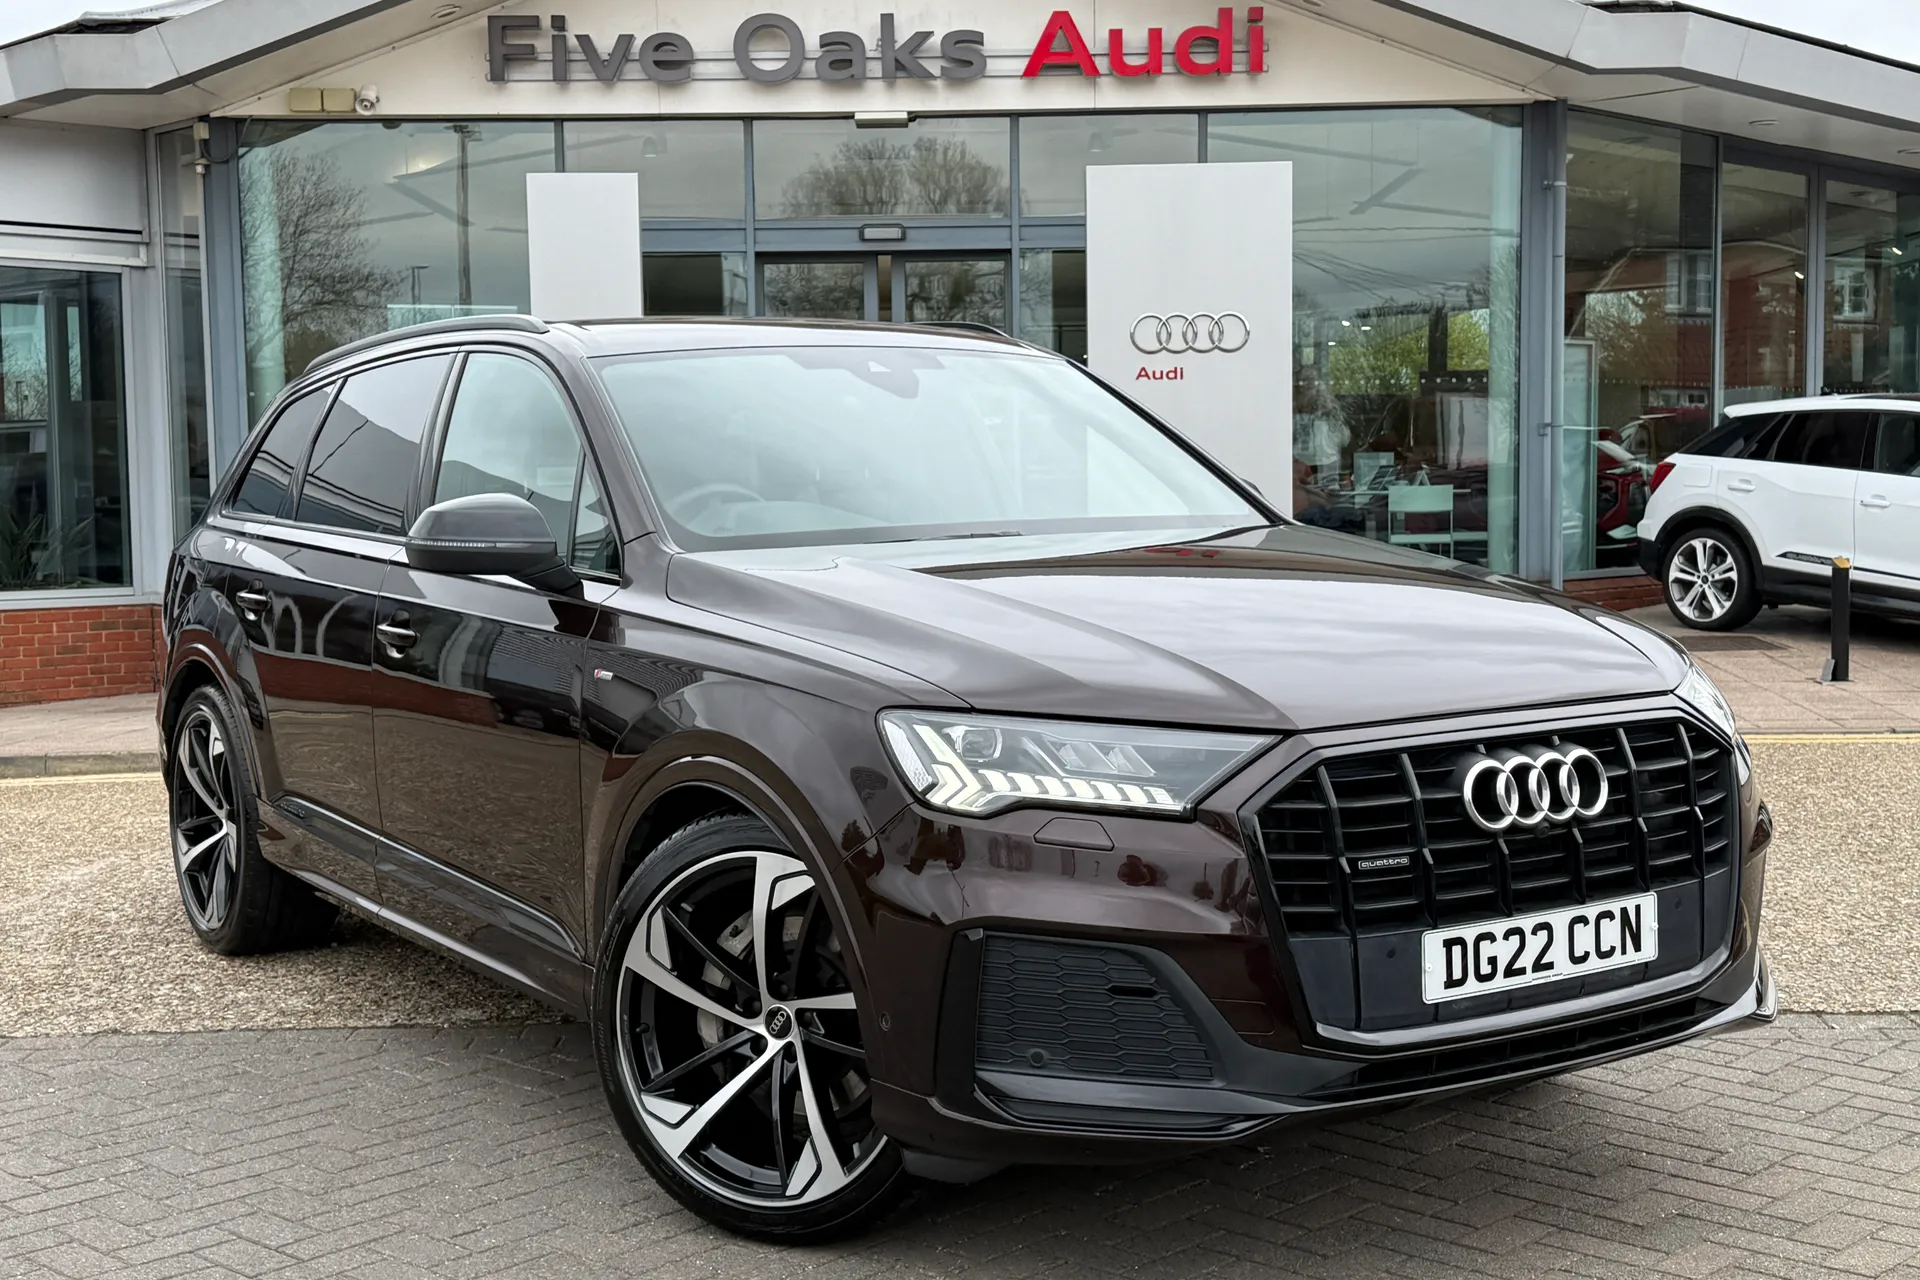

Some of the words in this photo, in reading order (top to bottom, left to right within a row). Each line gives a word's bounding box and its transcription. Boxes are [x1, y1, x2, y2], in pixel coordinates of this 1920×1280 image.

[487, 15, 694, 84] Five
[733, 12, 986, 85] Oaks
[1022, 7, 1265, 79] Audi
[1135, 366, 1185, 381] Audi
[1361, 858, 1409, 869] quattro
[1442, 921, 1555, 990] DG22
[1567, 903, 1643, 966] CCN
